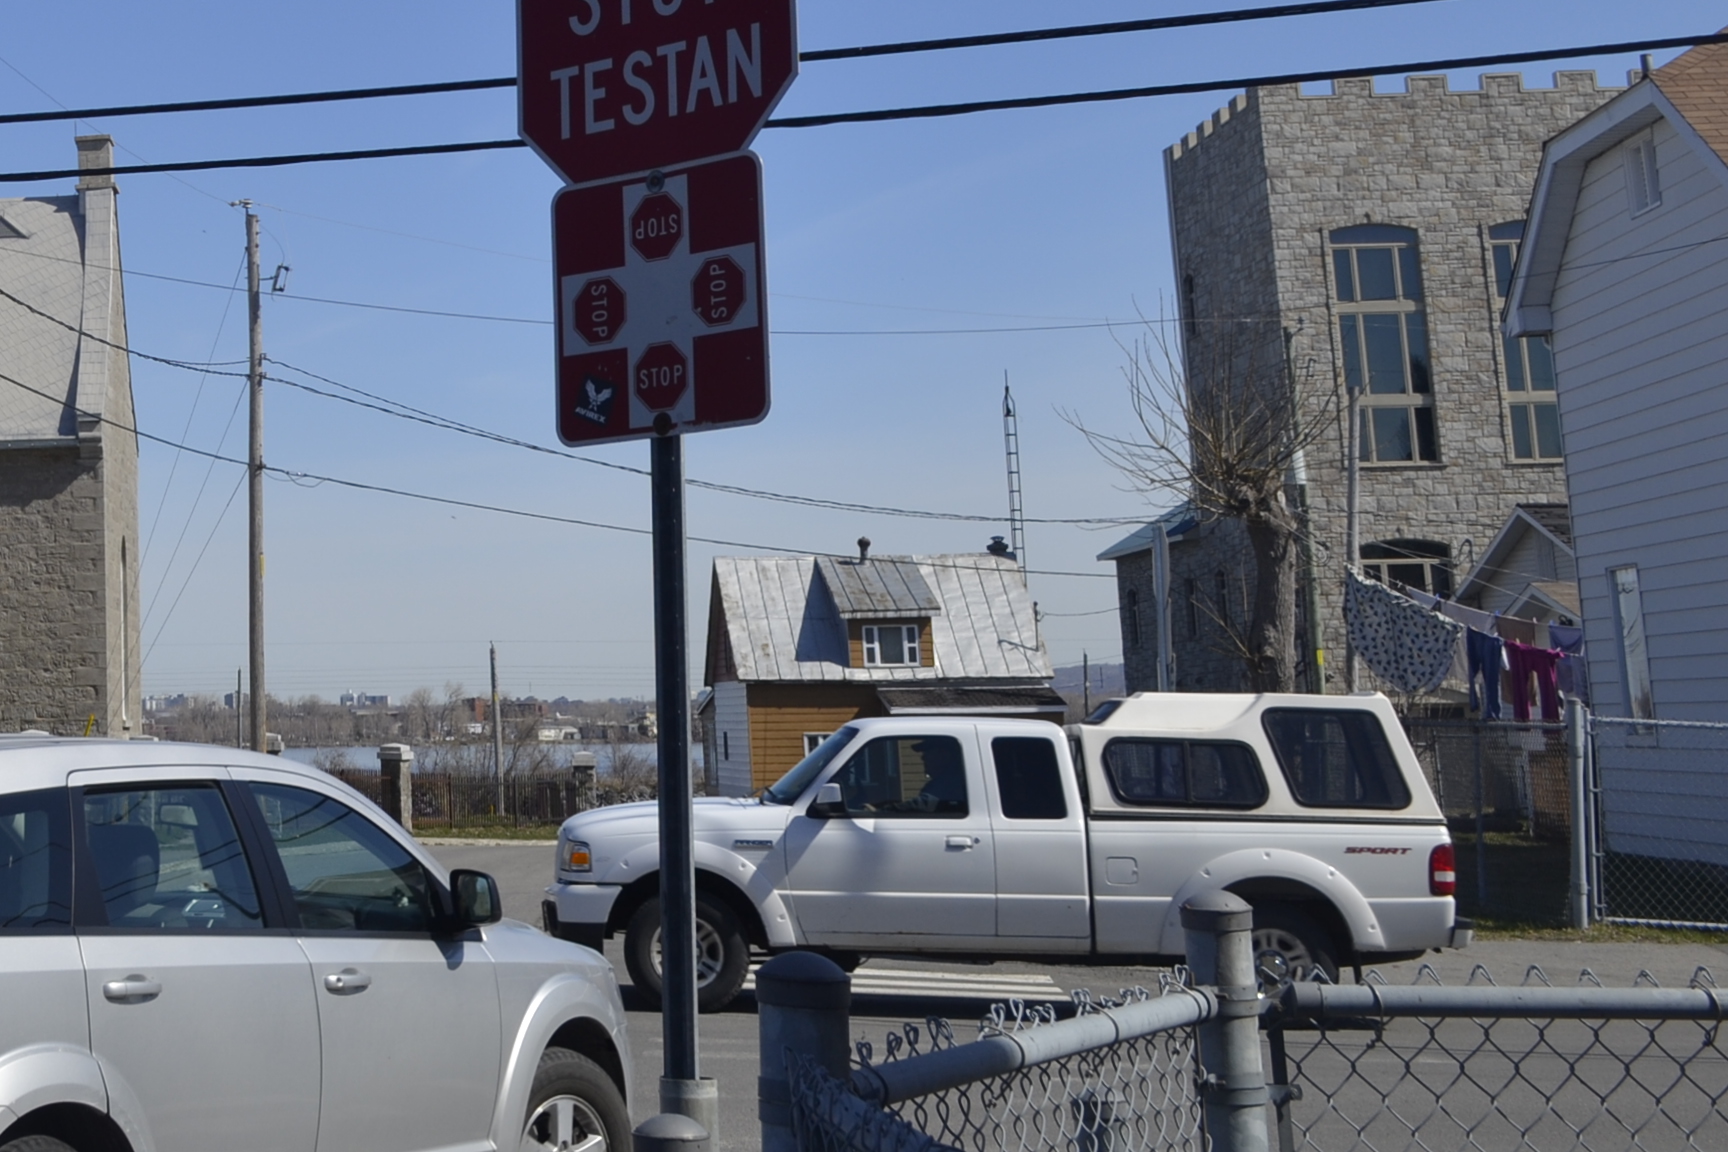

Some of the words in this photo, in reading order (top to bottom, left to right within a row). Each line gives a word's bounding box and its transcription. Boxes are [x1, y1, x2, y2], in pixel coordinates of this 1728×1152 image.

[550, 22, 762, 140] TESTAN
[635, 214, 678, 240] STOP
[710, 264, 727, 319] STOP
[591, 284, 608, 338] STOP
[639, 364, 683, 389] STOP
[575, 407, 606, 424] AVIREX
[1344, 847, 1412, 855] SPORT
